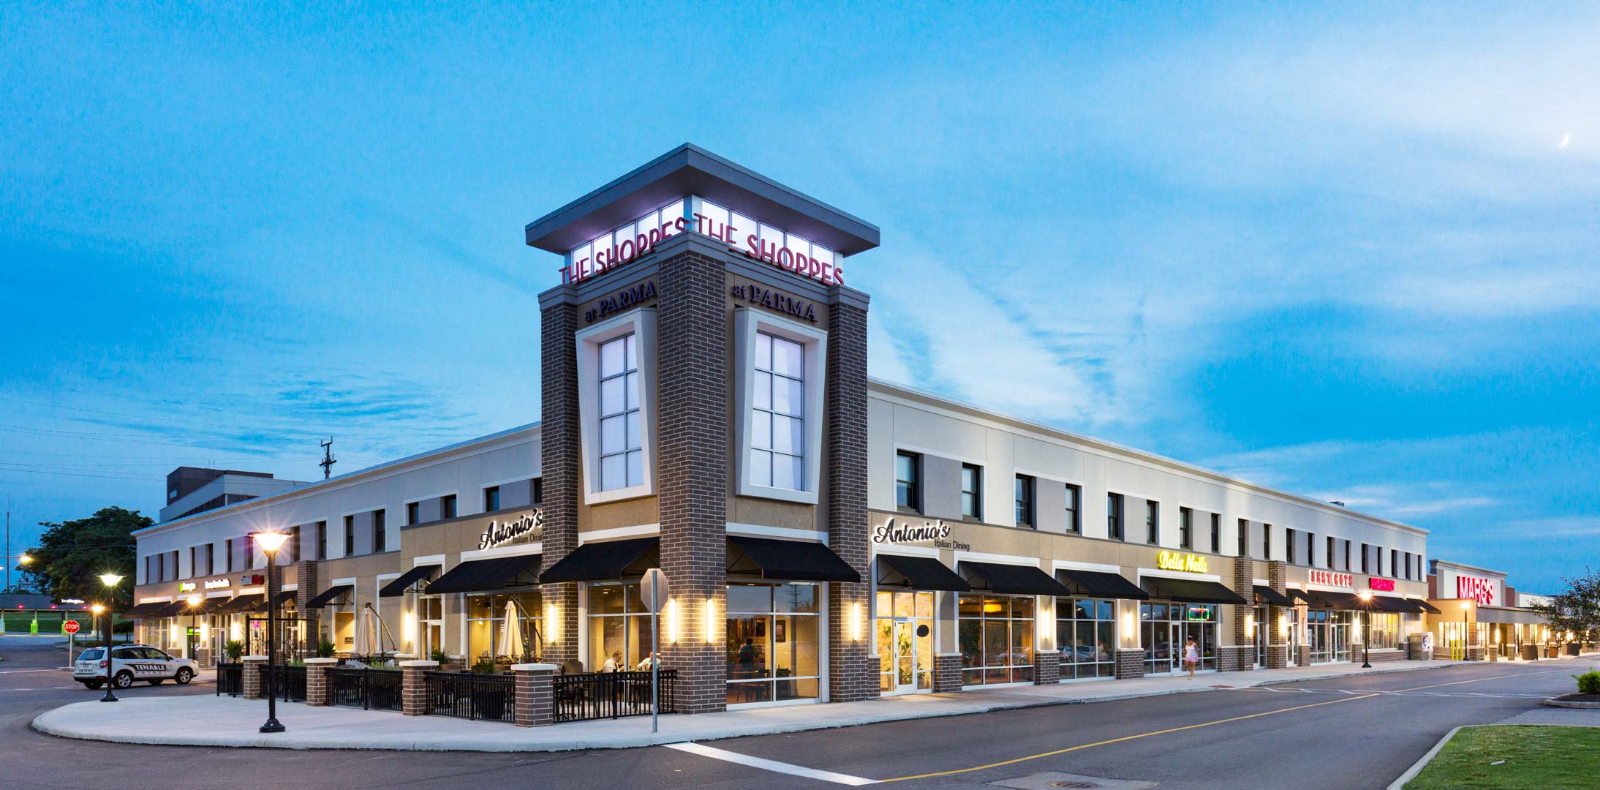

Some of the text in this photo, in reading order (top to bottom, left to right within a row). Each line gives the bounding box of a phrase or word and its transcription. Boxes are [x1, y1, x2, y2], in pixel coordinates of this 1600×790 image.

[558, 216, 691, 284] THE SHOPPES
[694, 212, 844, 287] THE SHOPPES
[585, 280, 658, 321] at PARMA
[732, 284, 818, 322] at PARMA
[478, 508, 542, 550] Antonio's
[873, 517, 951, 544] Antonio's
[934, 539, 971, 551] Italian Dining
[1158, 550, 1208, 573] Bella Nails
[1309, 569, 1353, 588] BEST CUTS
[1456, 574, 1496, 606] MARC'S
